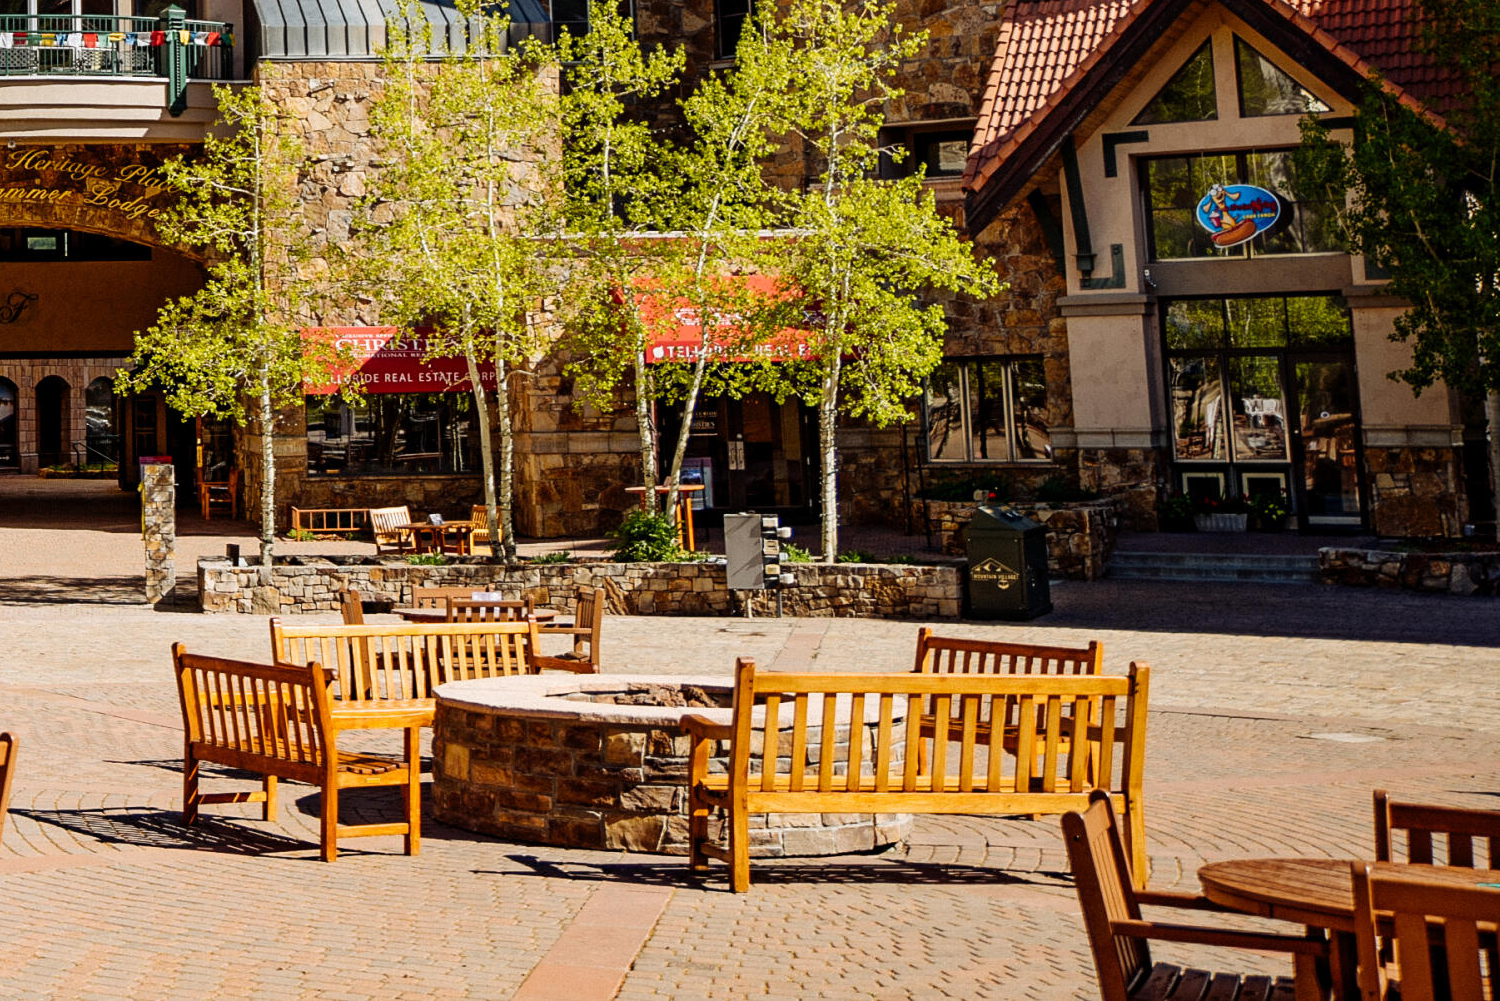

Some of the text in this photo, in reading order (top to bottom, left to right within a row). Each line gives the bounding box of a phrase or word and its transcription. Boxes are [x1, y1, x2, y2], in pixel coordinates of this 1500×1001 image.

[5, 149, 108, 181] Heritage
[84, 183, 161, 220] Lodge
[385, 372, 413, 383] REAL
[418, 370, 460, 382] ESTATE
[465, 370, 496, 381] CRP
